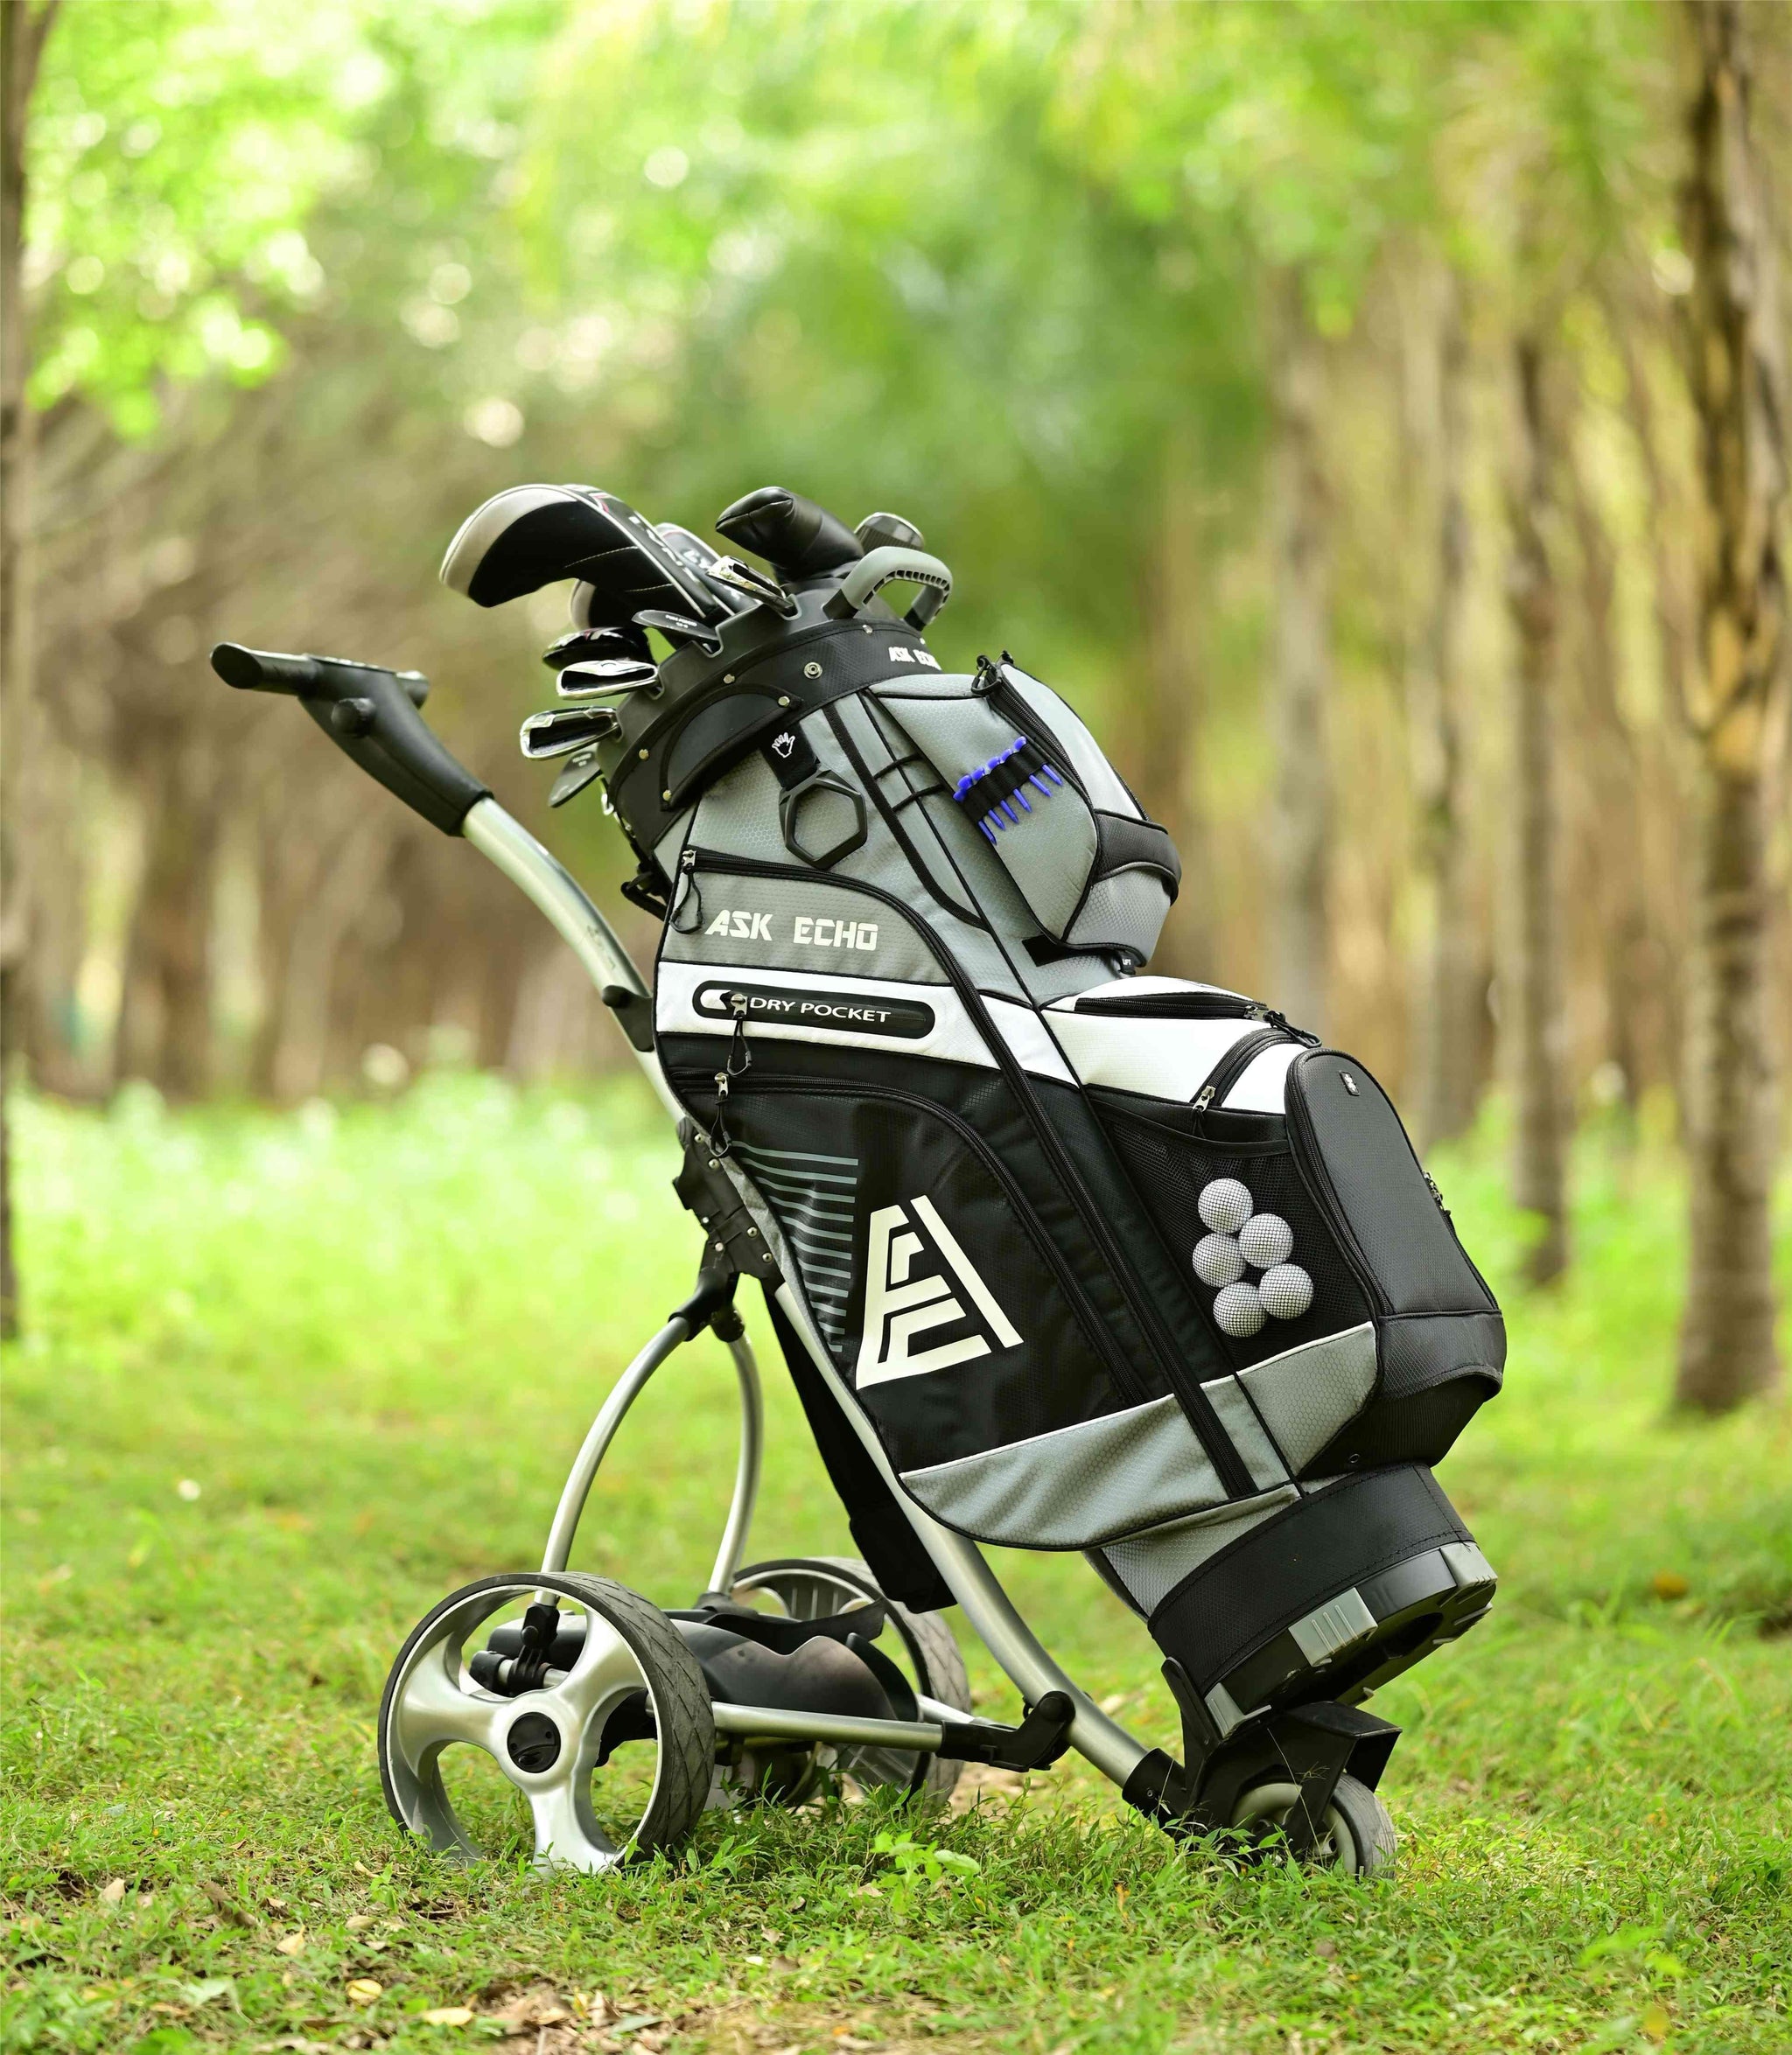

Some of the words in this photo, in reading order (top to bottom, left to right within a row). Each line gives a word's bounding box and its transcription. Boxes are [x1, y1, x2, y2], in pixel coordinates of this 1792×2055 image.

[888, 647, 916, 663] ASK
[704, 909, 774, 941] ASK
[793, 916, 879, 951] ECHO
[749, 997, 796, 1012] DRY
[800, 1003, 892, 1023] POCKET
